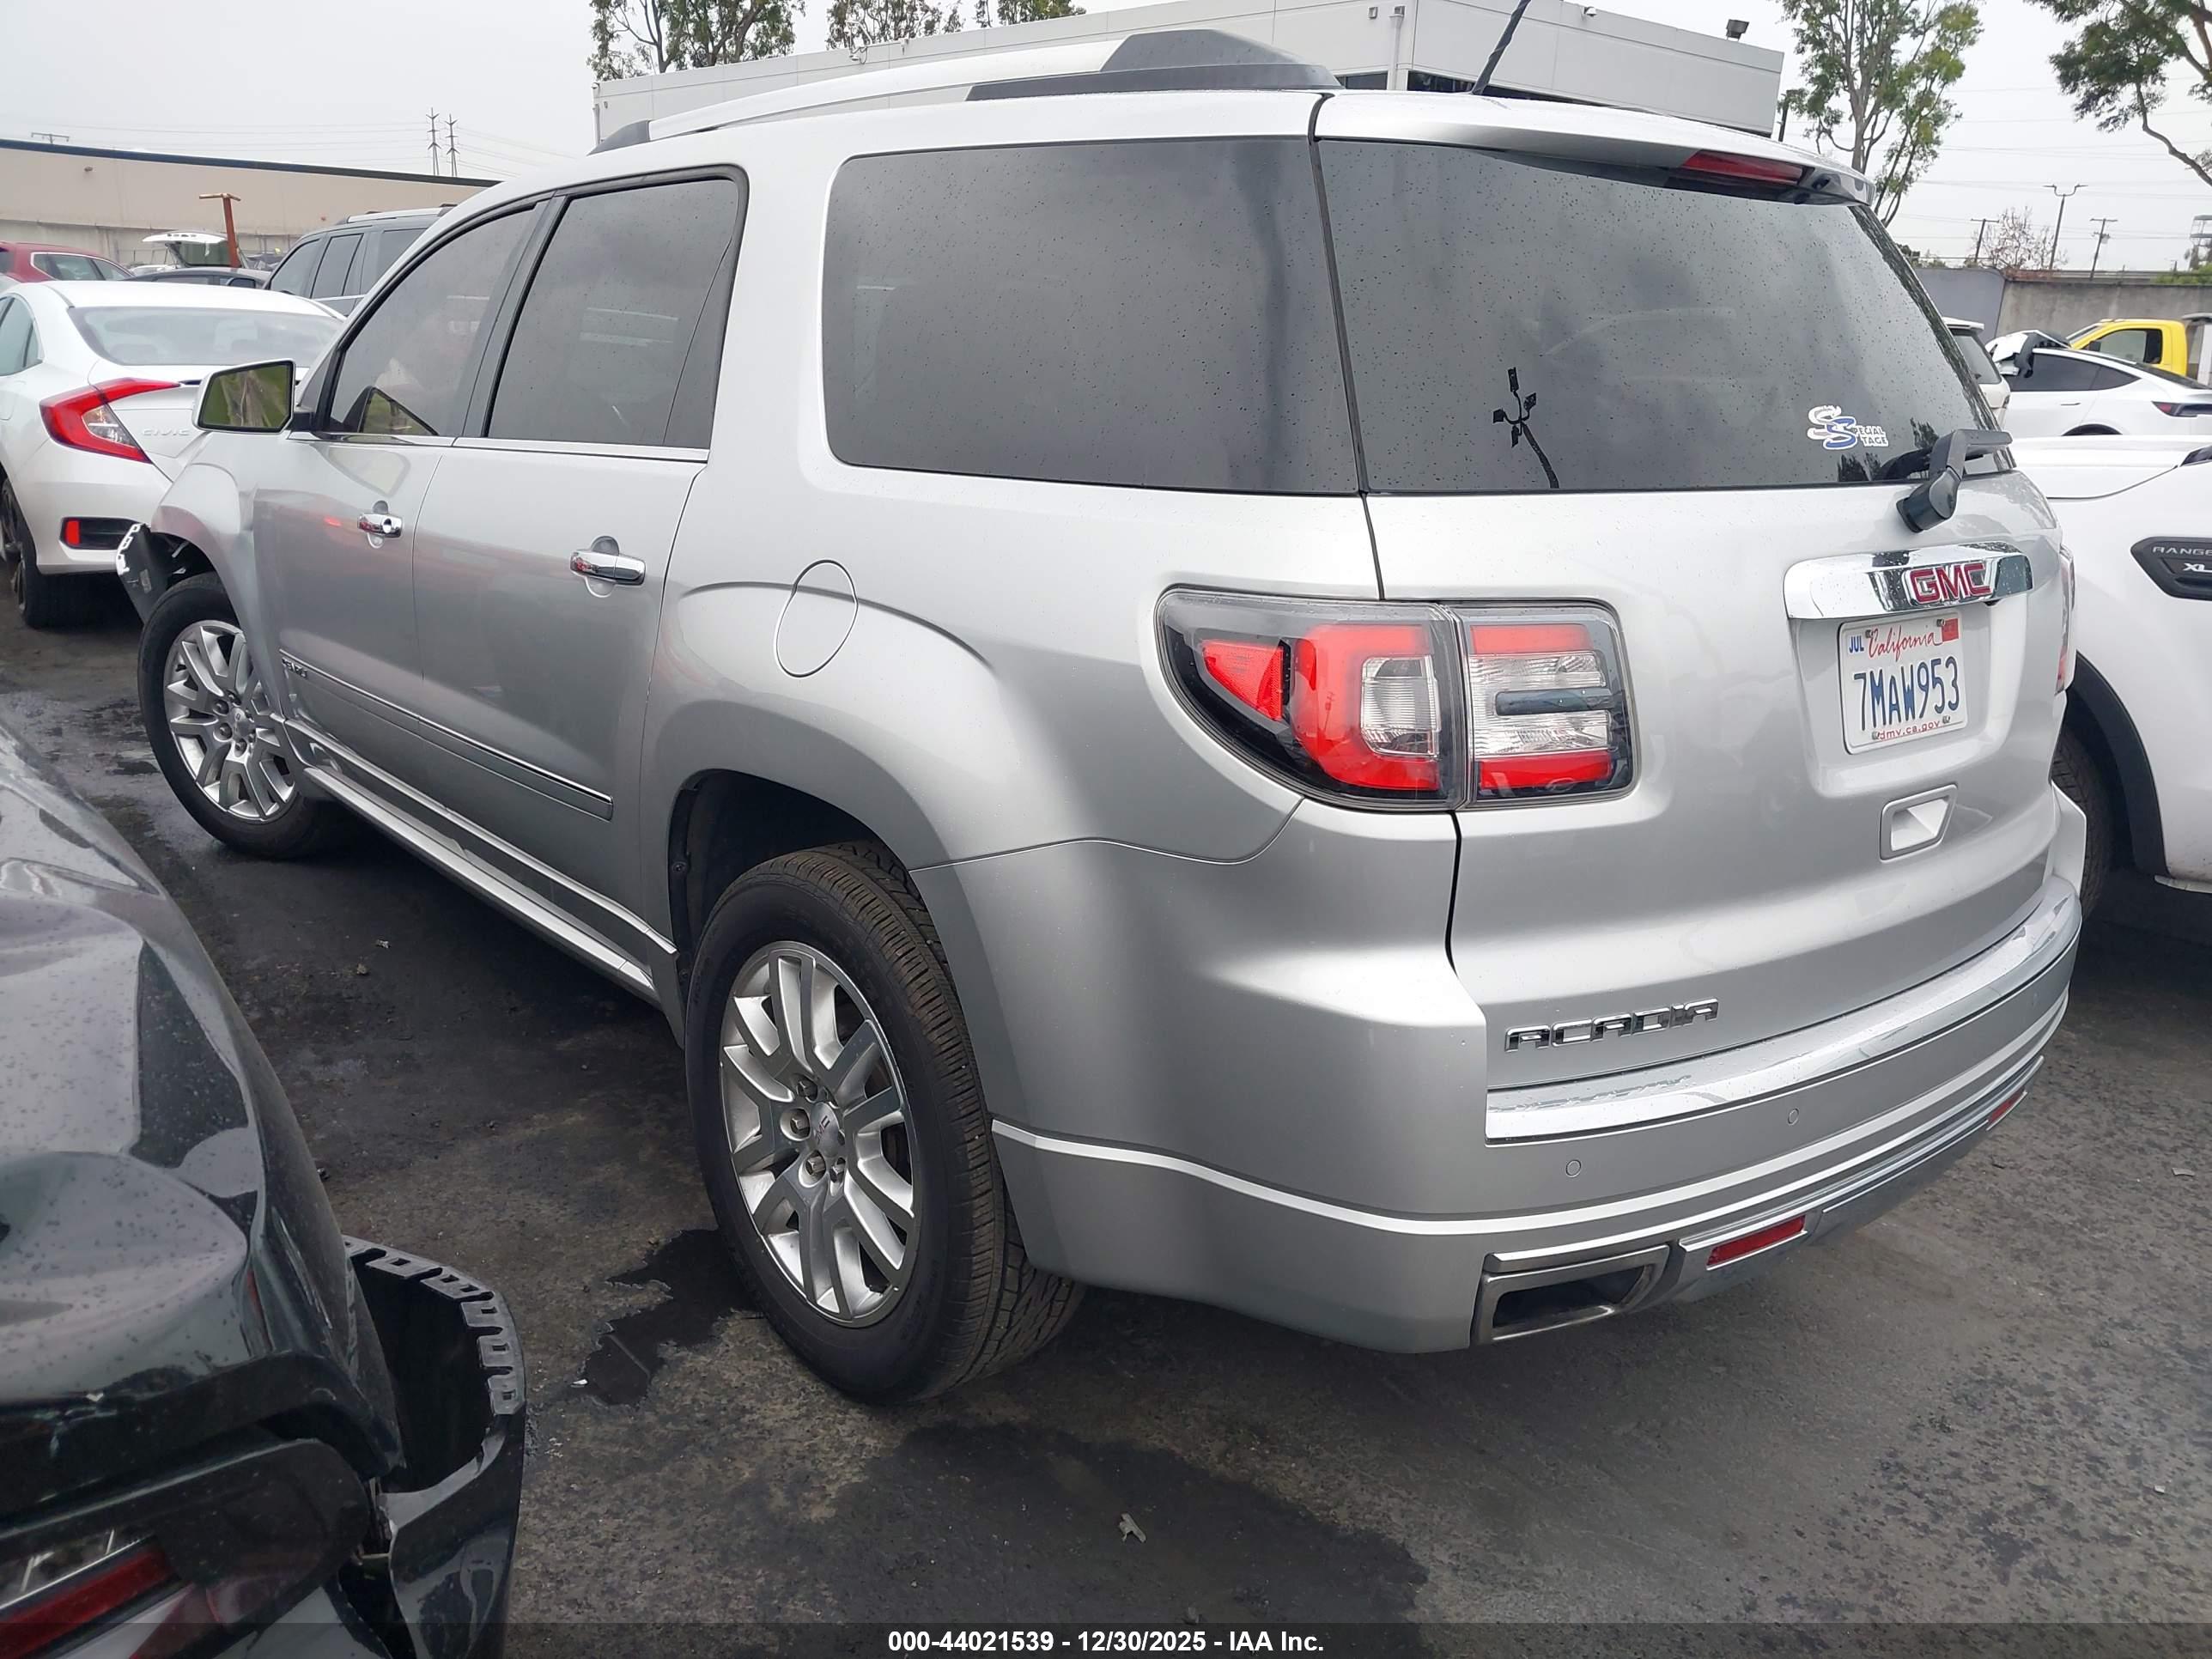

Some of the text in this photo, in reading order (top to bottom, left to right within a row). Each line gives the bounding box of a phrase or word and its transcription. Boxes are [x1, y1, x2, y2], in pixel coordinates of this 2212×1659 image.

[143, 428, 190, 437] CIVIC
[1909, 562, 1991, 605] GMC
[1849, 635, 1864, 653] JUL
[1868, 624, 1942, 663] California
[1853, 655, 1960, 732] 7MAW953
[1878, 720, 1941, 741] dmv.ca.gov
[1504, 997, 1719, 1054] ACADIA
